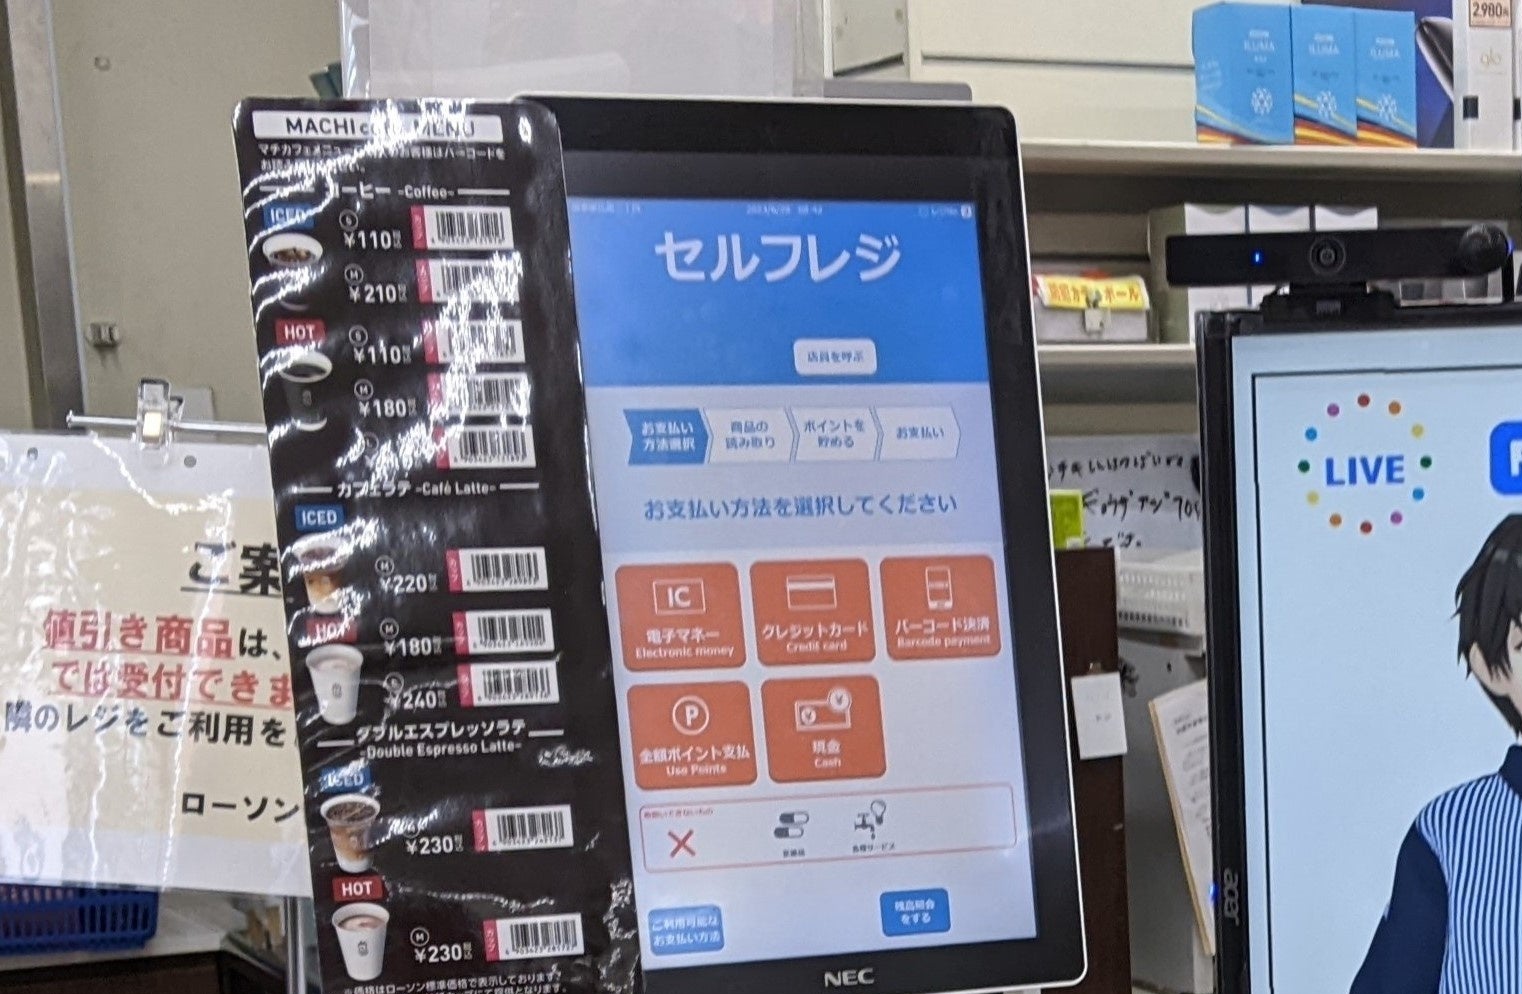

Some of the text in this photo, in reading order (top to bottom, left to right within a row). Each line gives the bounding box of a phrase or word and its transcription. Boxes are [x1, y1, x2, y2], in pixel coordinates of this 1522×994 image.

[286, 117, 355, 136] MACHI
[654, 230, 901, 283] セルフレジ
[285, 324, 316, 341] HOT
[1325, 454, 1406, 487] LIVE
[301, 508, 338, 526] ICED
[644, 493, 958, 522] お支払い方法を選択してください
[666, 586, 691, 609] IC
[41, 609, 282, 661] 値引き商品は、
[762, 622, 869, 641] クレジットカード
[356, 718, 527, 743] ダブルエスプレッソラテ
[181, 792, 300, 824] ローソン
[341, 880, 374, 897] HOT
[823, 967, 876, 988] NEC
